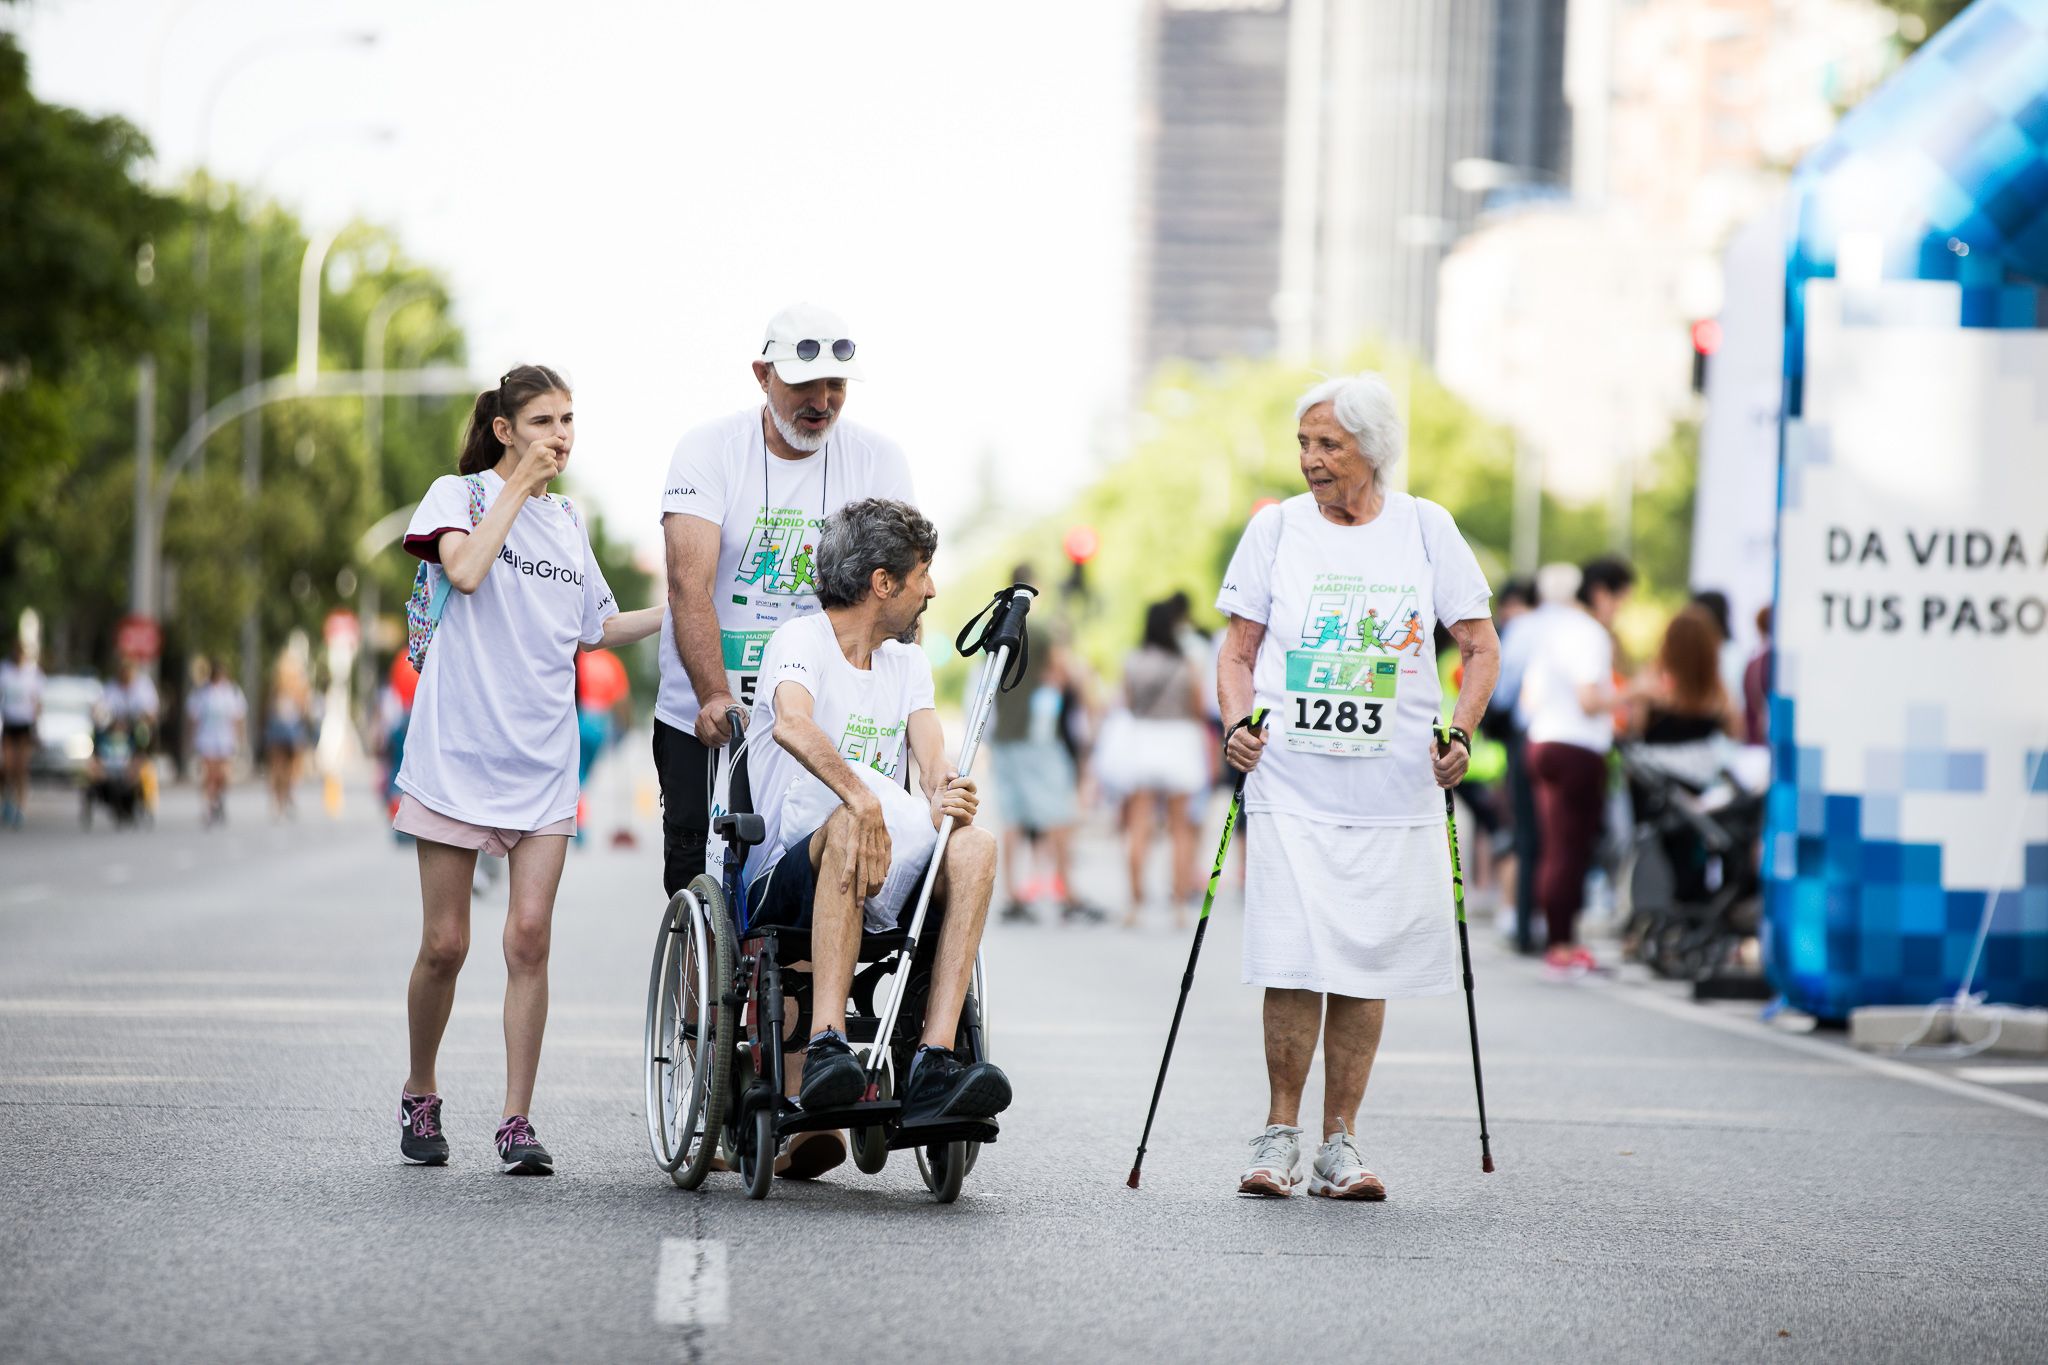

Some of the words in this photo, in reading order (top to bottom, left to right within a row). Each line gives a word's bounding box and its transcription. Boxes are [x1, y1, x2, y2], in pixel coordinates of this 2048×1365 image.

[755, 516, 805, 527] MADRID
[771, 507, 803, 515] Carrera
[1827, 528, 1887, 565] DA
[1906, 529, 2027, 567] VIDA
[1312, 583, 1366, 593] MADRID
[1369, 584, 1398, 593] CON
[1401, 585, 1417, 593] LA
[1822, 592, 1903, 631] TUS
[1306, 660, 1375, 693] ELA
[1295, 697, 1384, 735] 1283
